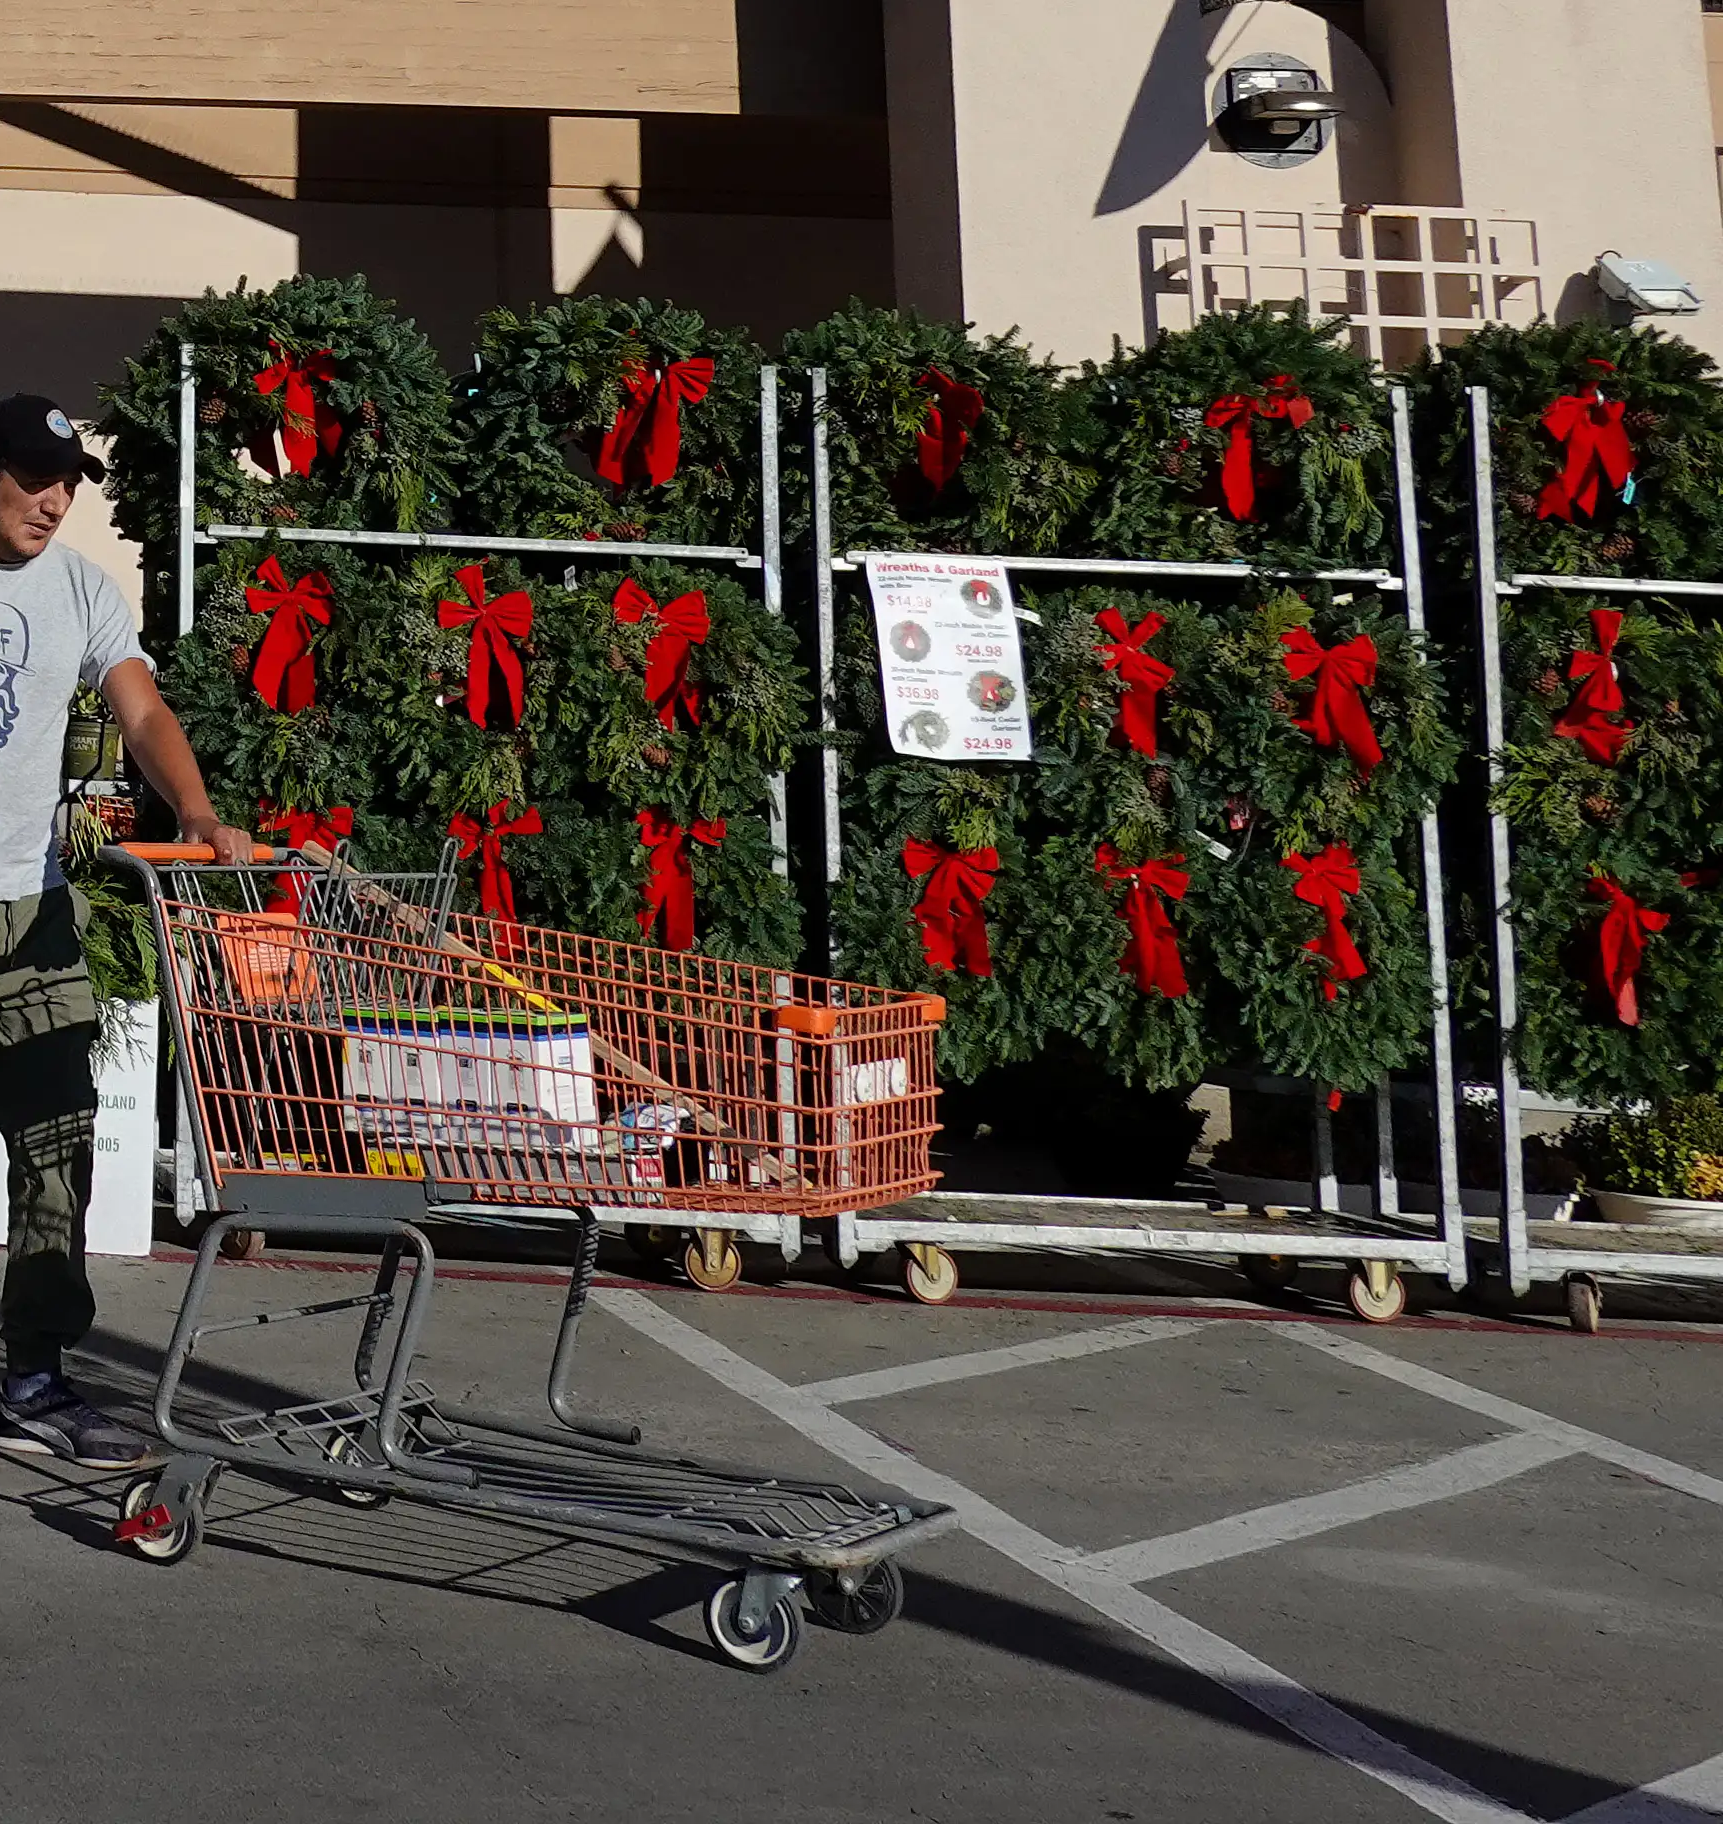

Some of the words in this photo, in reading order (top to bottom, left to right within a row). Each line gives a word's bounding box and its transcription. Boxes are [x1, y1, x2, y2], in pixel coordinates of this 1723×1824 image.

[875, 562, 930, 573] Wreaths
[934, 564, 944, 573] &
[948, 565, 1000, 577] Garland
[955, 644, 1003, 657] $24.98
[897, 685, 939, 700] $36.98
[963, 737, 1012, 749] $24.98
[98, 1094, 136, 1110] RLAND
[94, 1136, 120, 1152] -005
